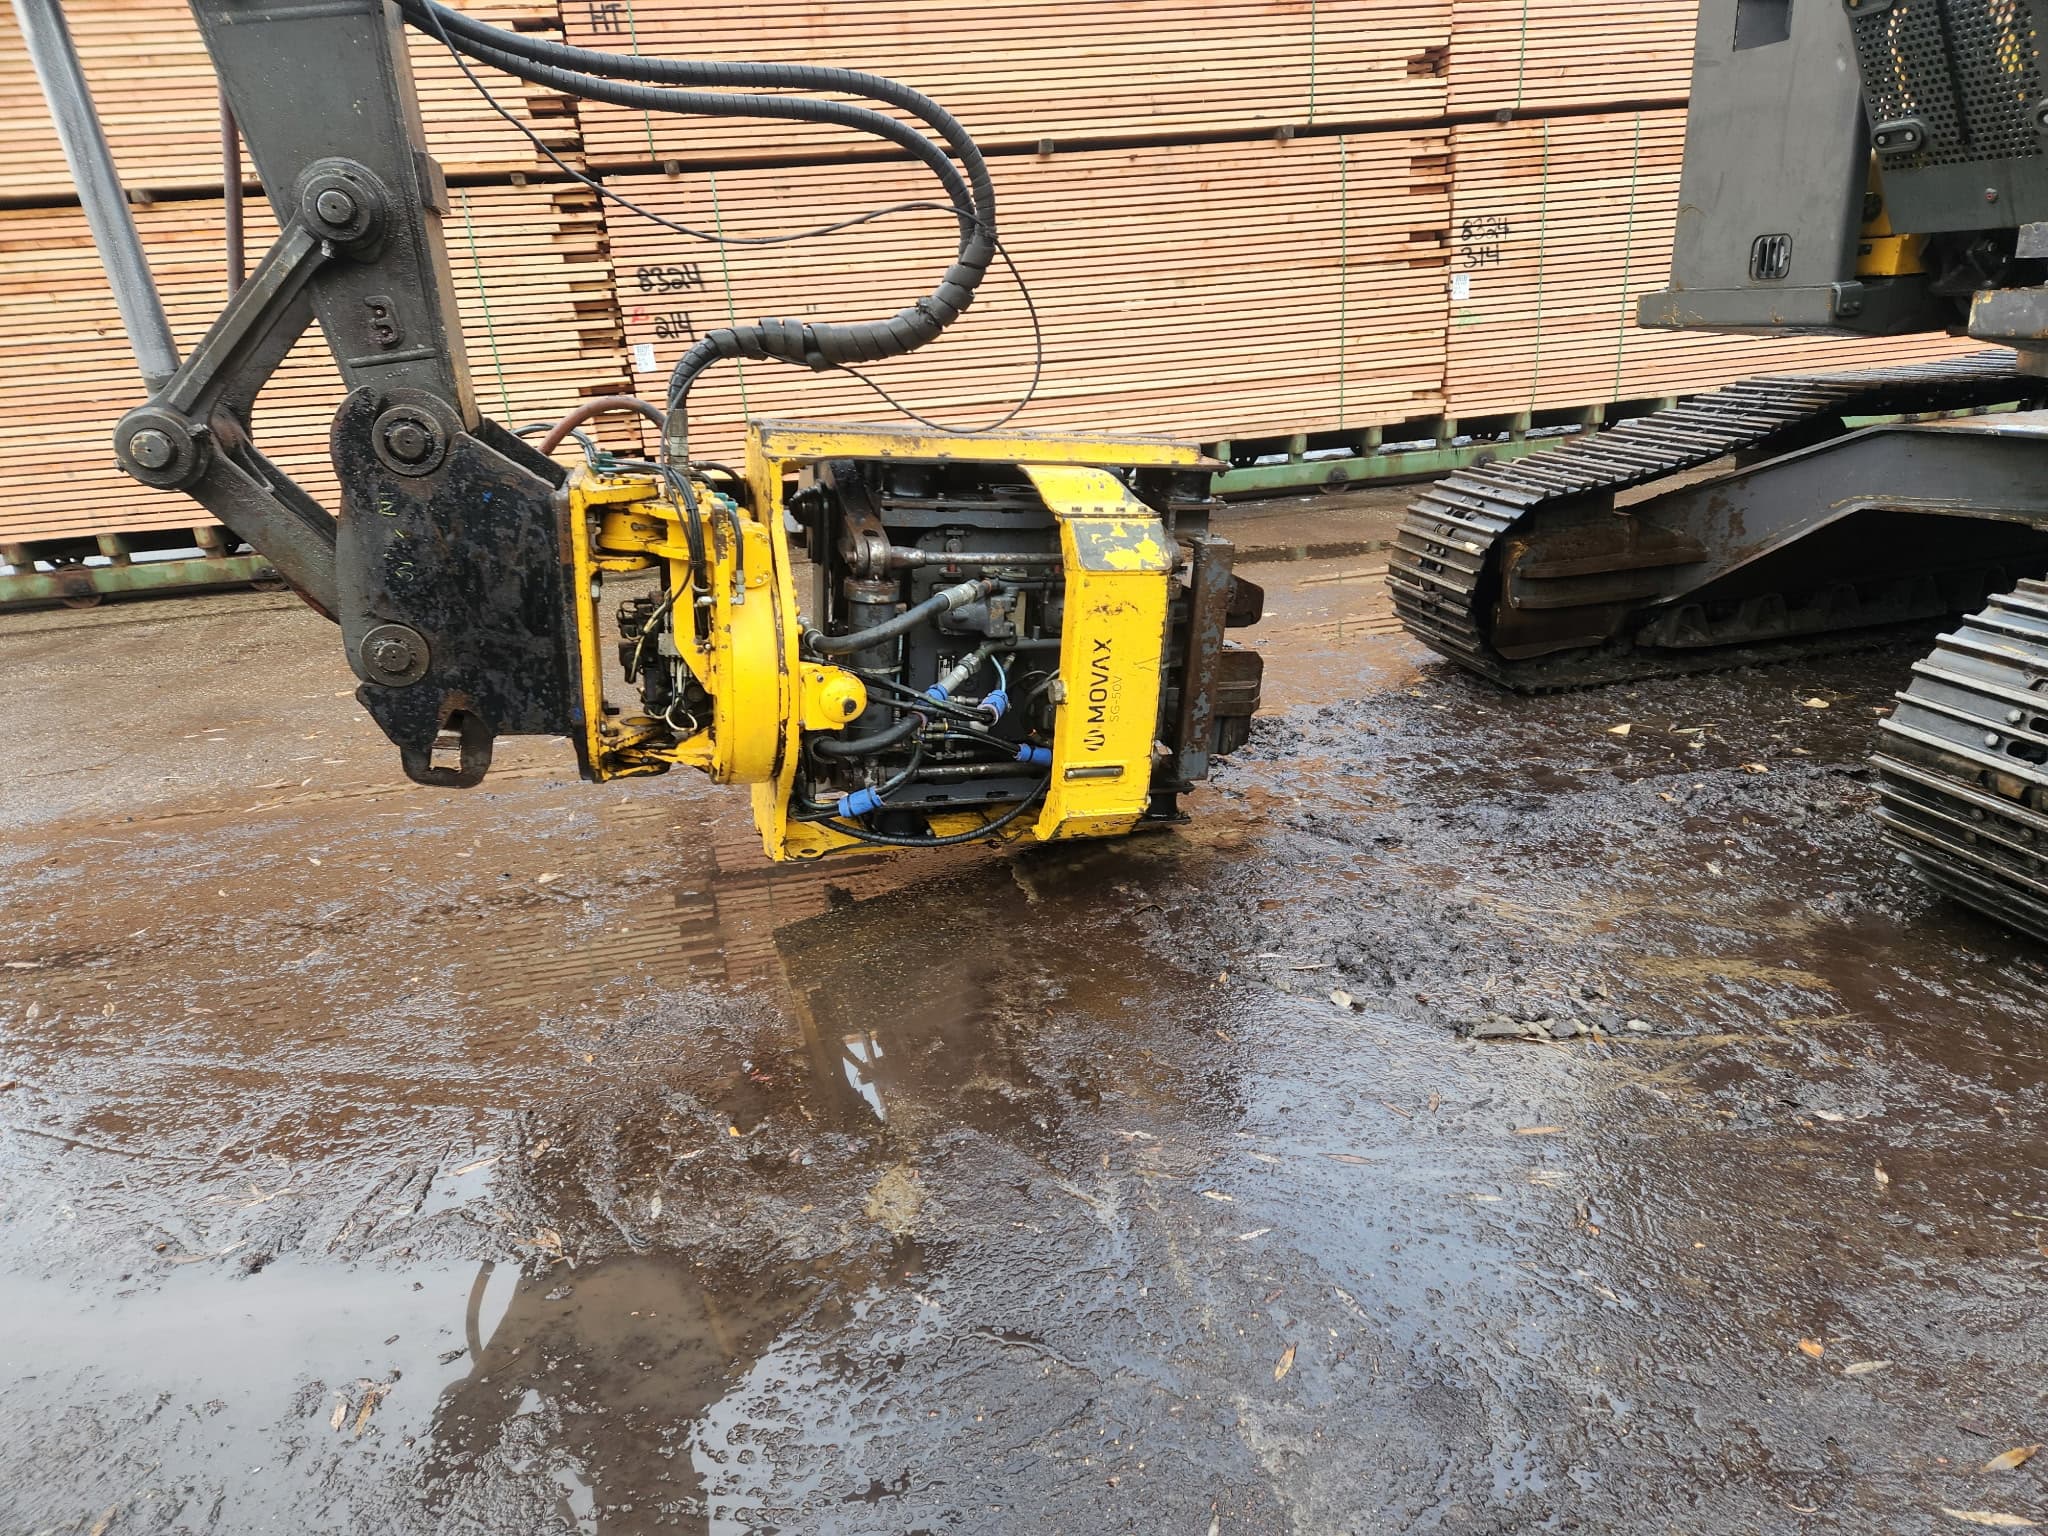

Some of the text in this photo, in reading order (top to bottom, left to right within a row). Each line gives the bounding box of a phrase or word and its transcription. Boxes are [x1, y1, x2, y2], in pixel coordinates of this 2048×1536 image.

[589, 2, 621, 32] HT
[1460, 243, 1499, 268] 314
[637, 262, 705, 292] 8324
[654, 312, 695, 340] 214
[1087, 638, 1112, 723] MOVAX
